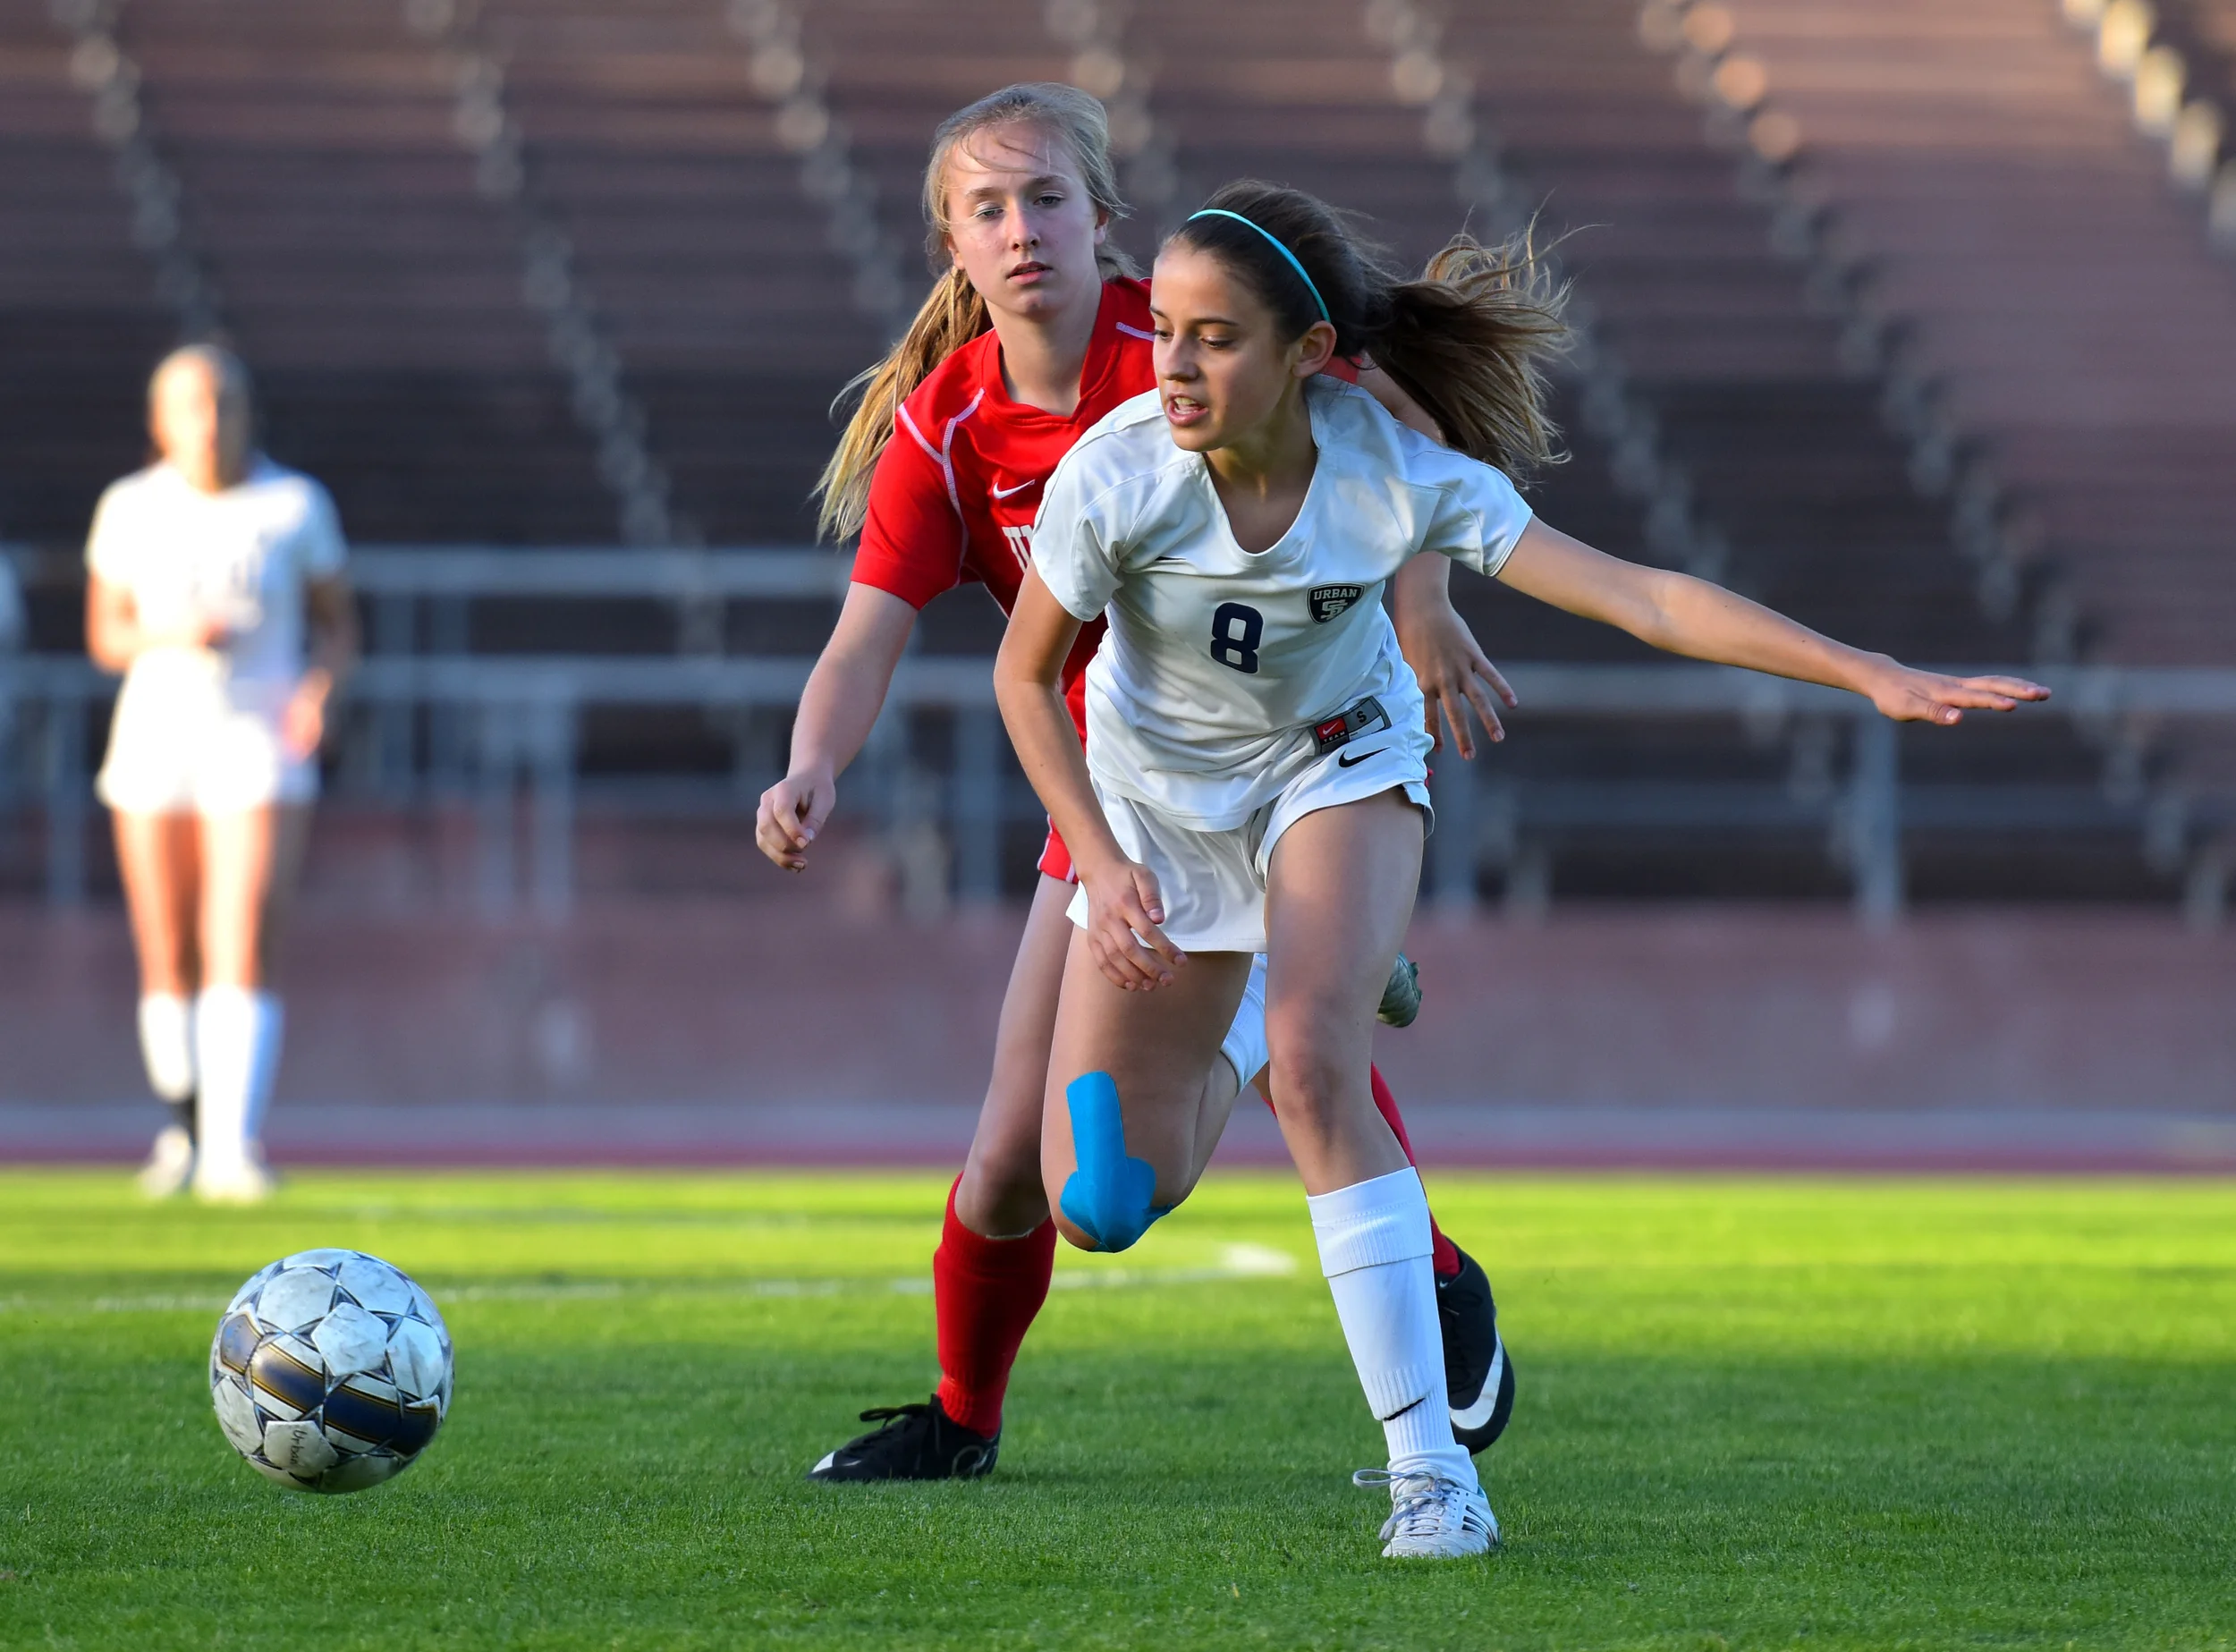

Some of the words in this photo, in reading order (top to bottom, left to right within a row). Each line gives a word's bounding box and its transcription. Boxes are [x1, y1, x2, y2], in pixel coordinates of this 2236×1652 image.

[1314, 589, 1358, 600] URBAN
[1210, 601, 1264, 674] 8
[1357, 711, 1367, 723] S
[1324, 731, 1345, 743] TEAM
[289, 1429, 308, 1464] Urban
